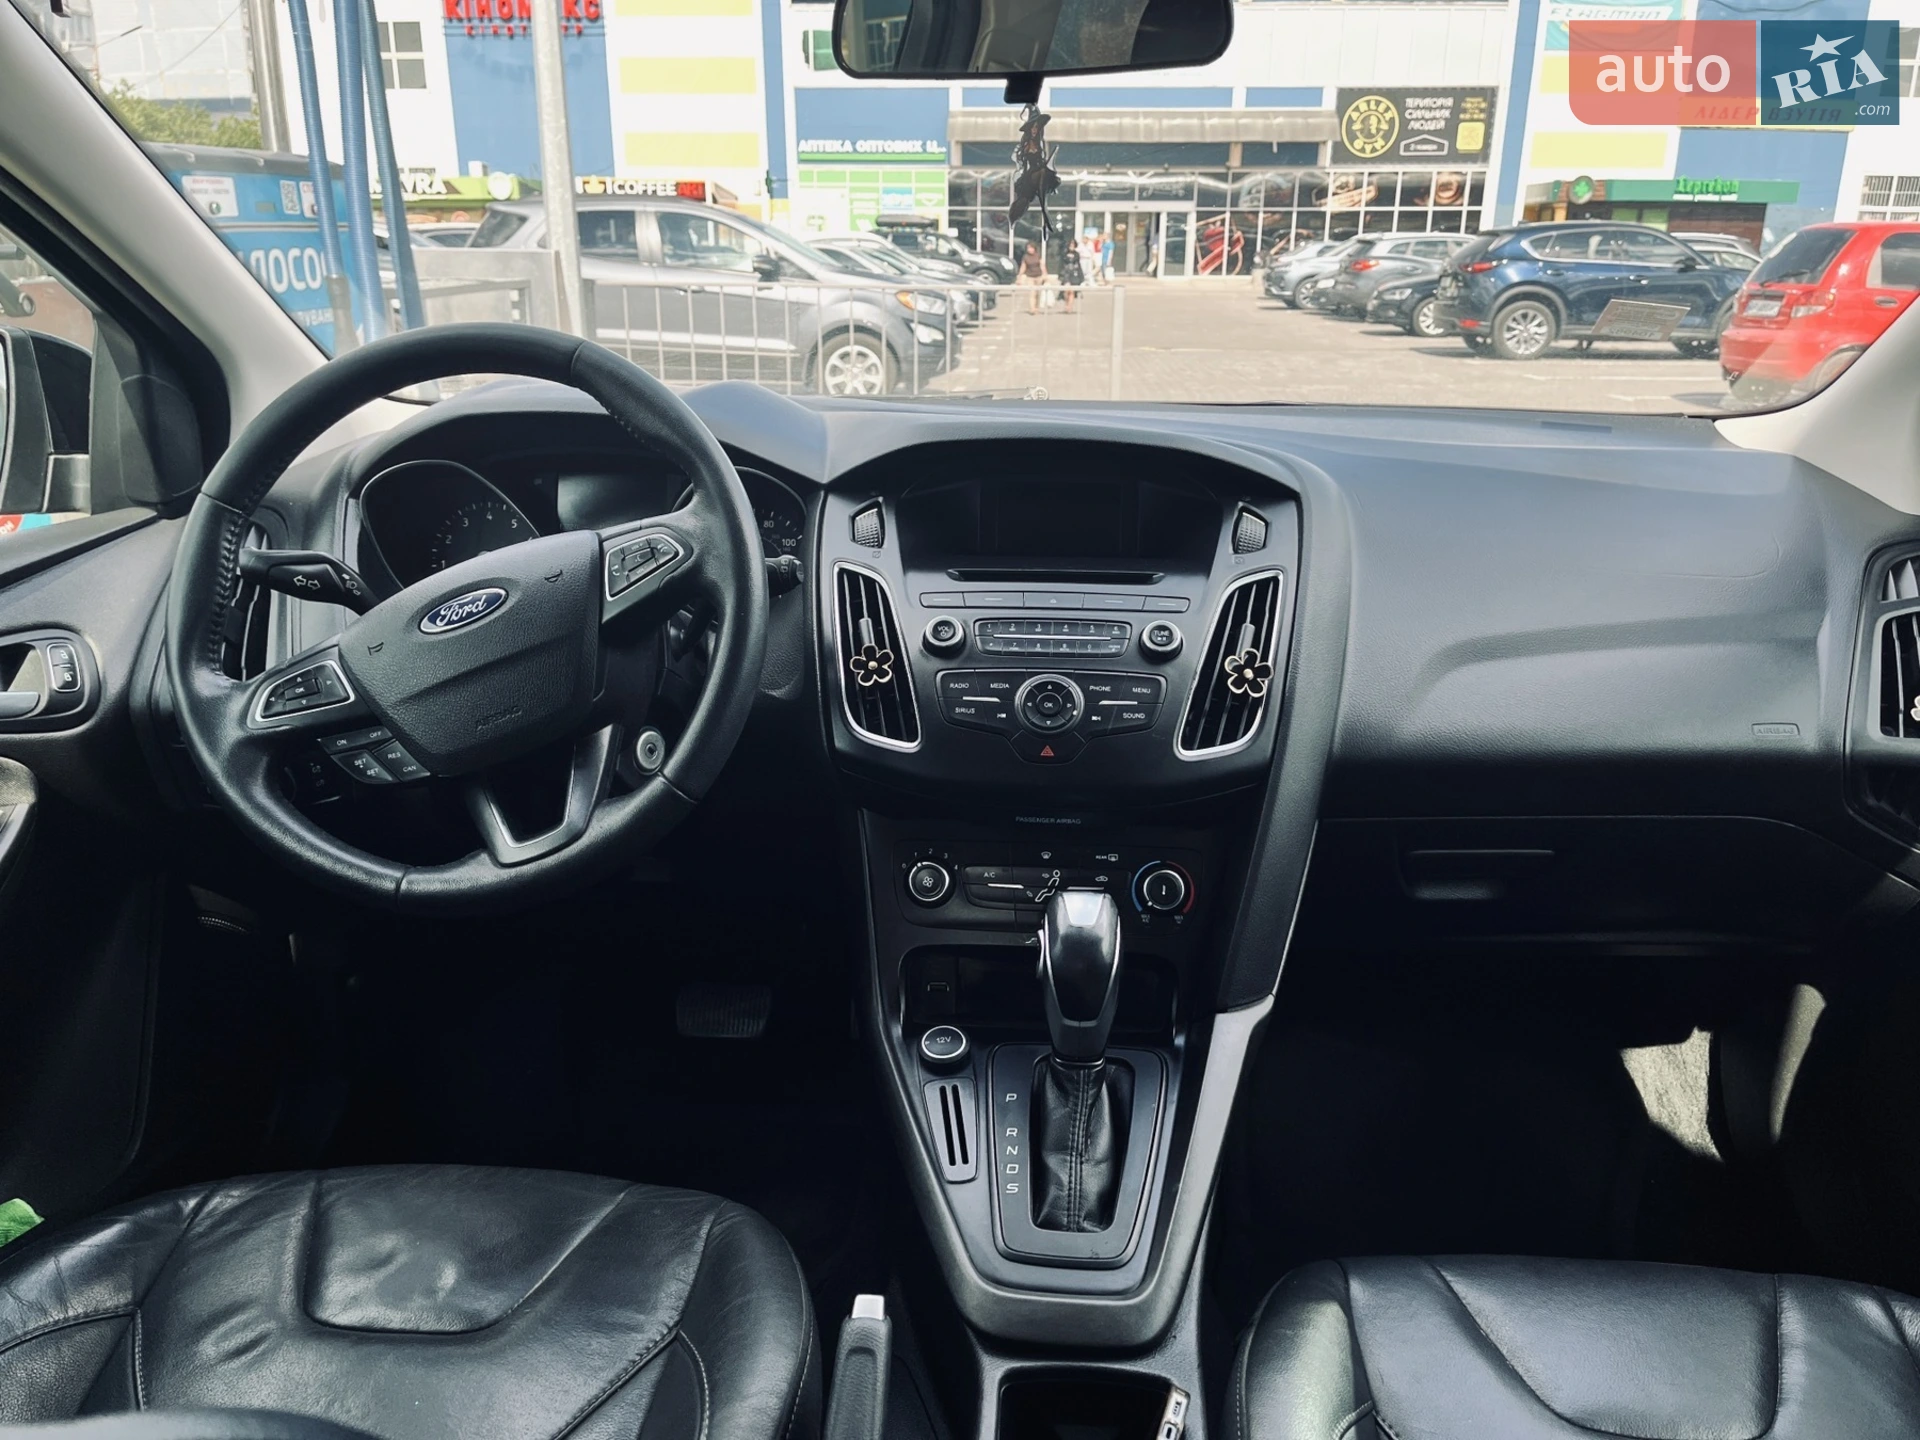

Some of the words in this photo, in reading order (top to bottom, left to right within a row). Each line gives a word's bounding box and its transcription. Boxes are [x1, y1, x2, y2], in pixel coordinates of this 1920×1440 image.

[798, 140, 853, 152] АПТЕКА
[855, 140, 923, 152] ОПТОВИХ
[486, 512, 493, 520] 4
[463, 518, 469, 527] 3
[511, 519, 518, 529] 5
[763, 520, 775, 528] 80
[445, 535, 452, 544] 2
[781, 538, 797, 547] 100
[436, 595, 487, 627] Ford
[369, 731, 382, 739] OFF
[354, 758, 366, 766] SET
[1006, 1093, 1017, 1102] P
[1006, 1127, 1018, 1137] R
[1006, 1145, 1018, 1155] N
[1006, 1163, 1019, 1174] D
[1006, 1183, 1019, 1193] S
